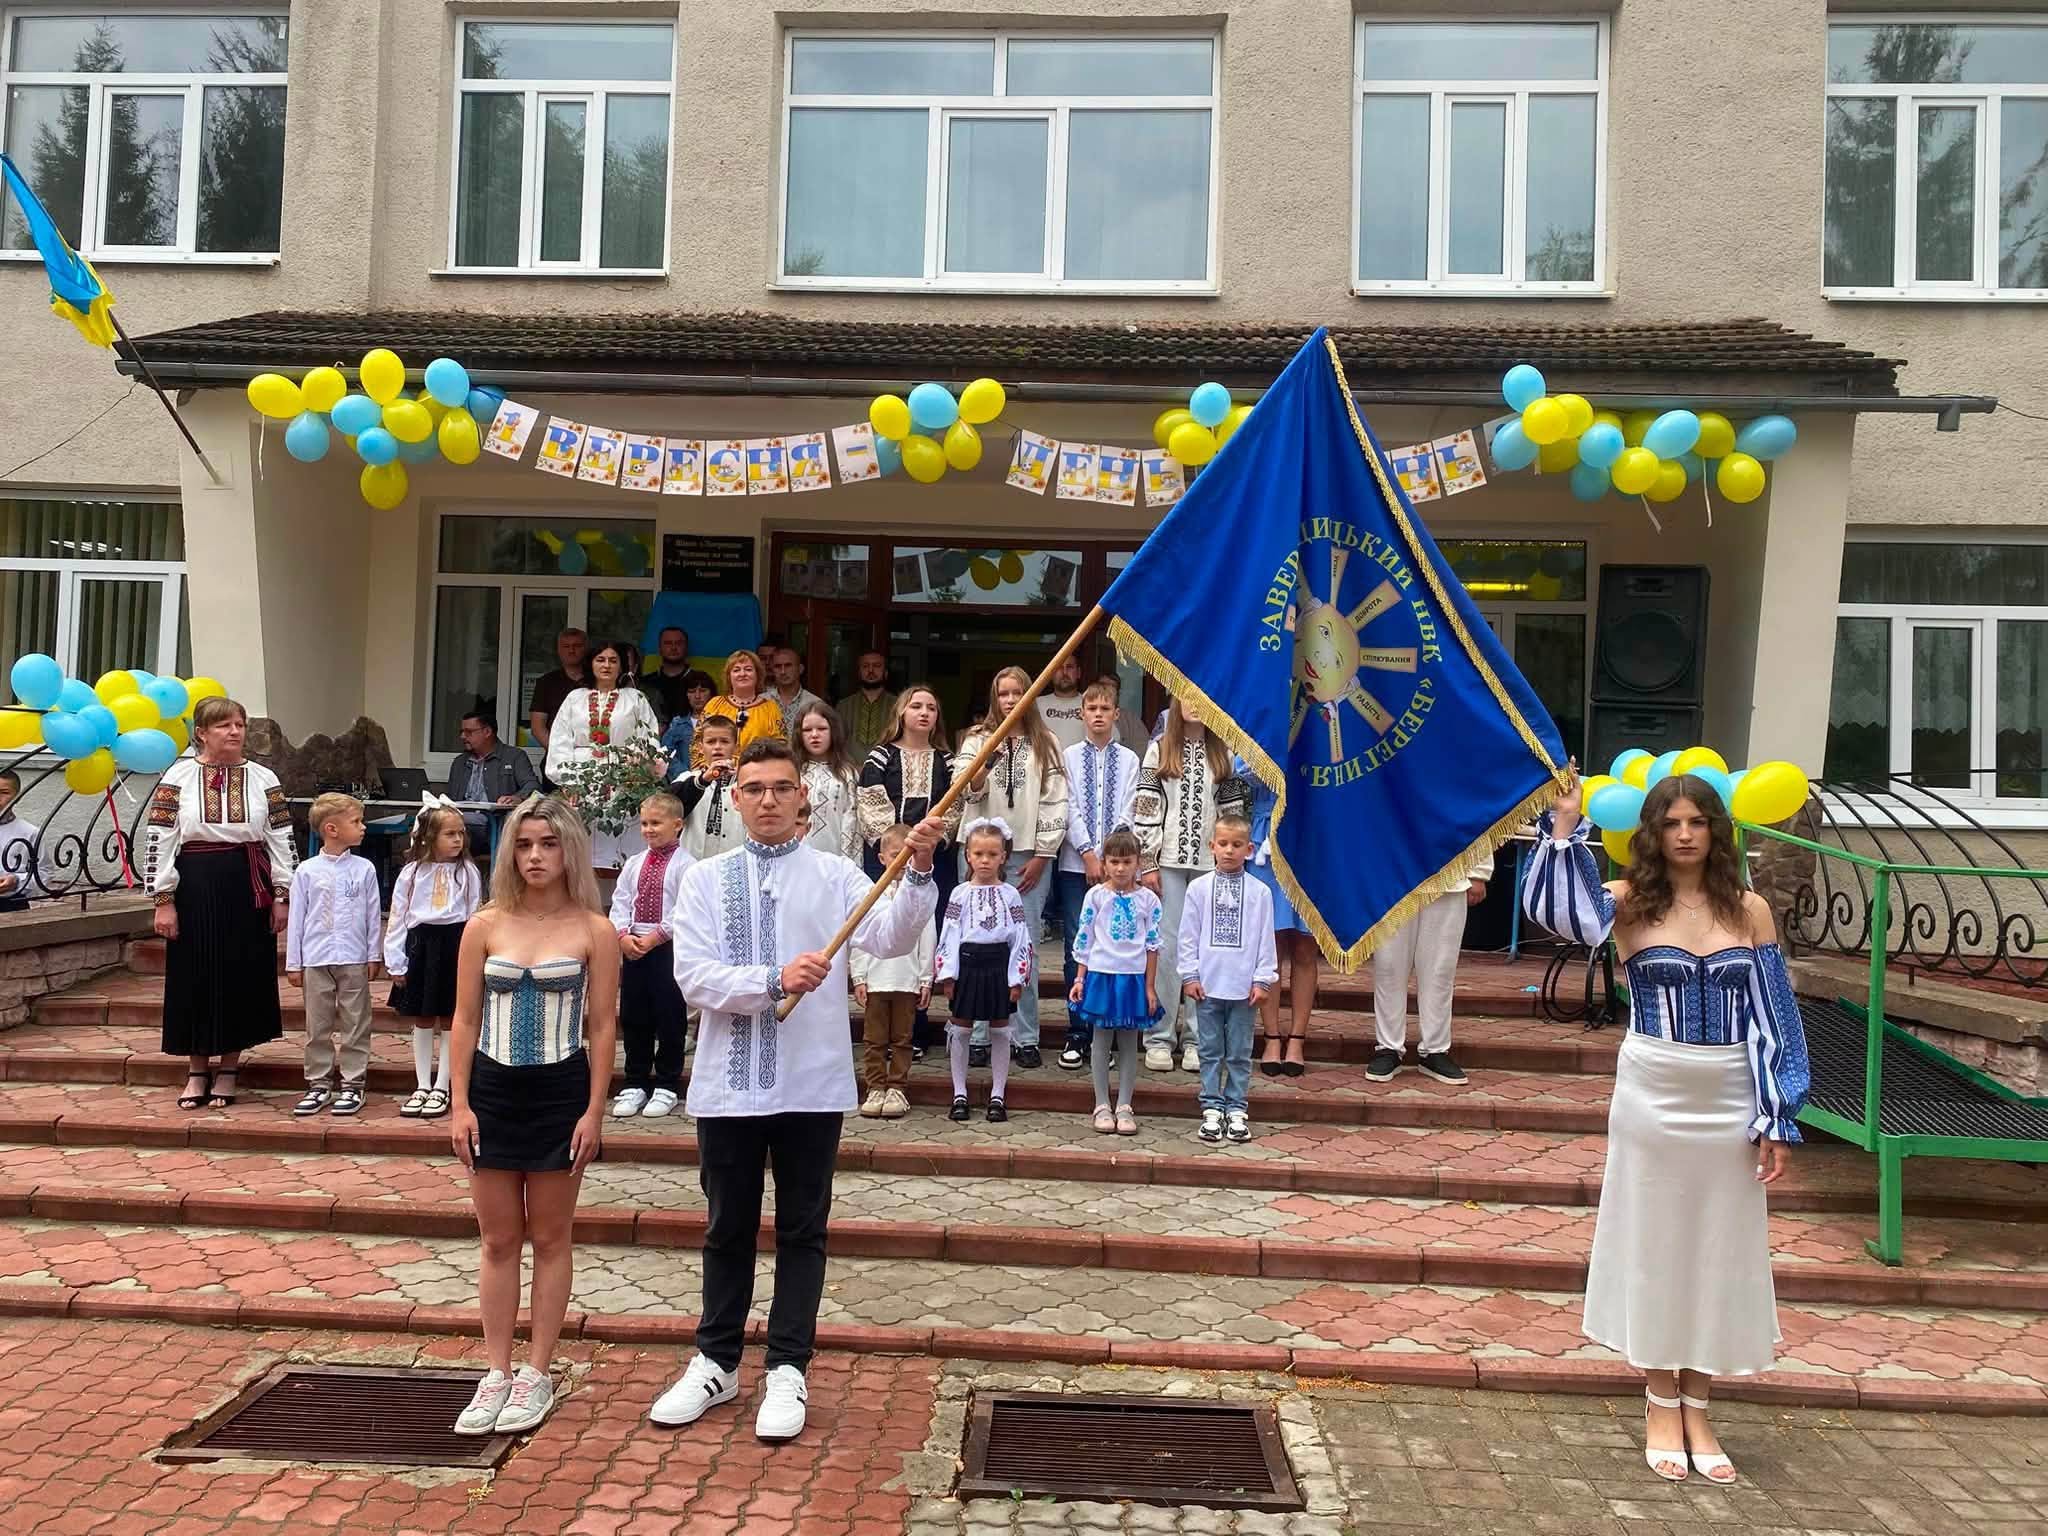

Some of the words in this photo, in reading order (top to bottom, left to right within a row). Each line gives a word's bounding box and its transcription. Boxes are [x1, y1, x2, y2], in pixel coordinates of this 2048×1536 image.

[542, 426, 822, 481] ВЕРЕСНЯ
[1354, 597, 1382, 623] ДОБРОТА
[1411, 599, 1442, 664] НВК
